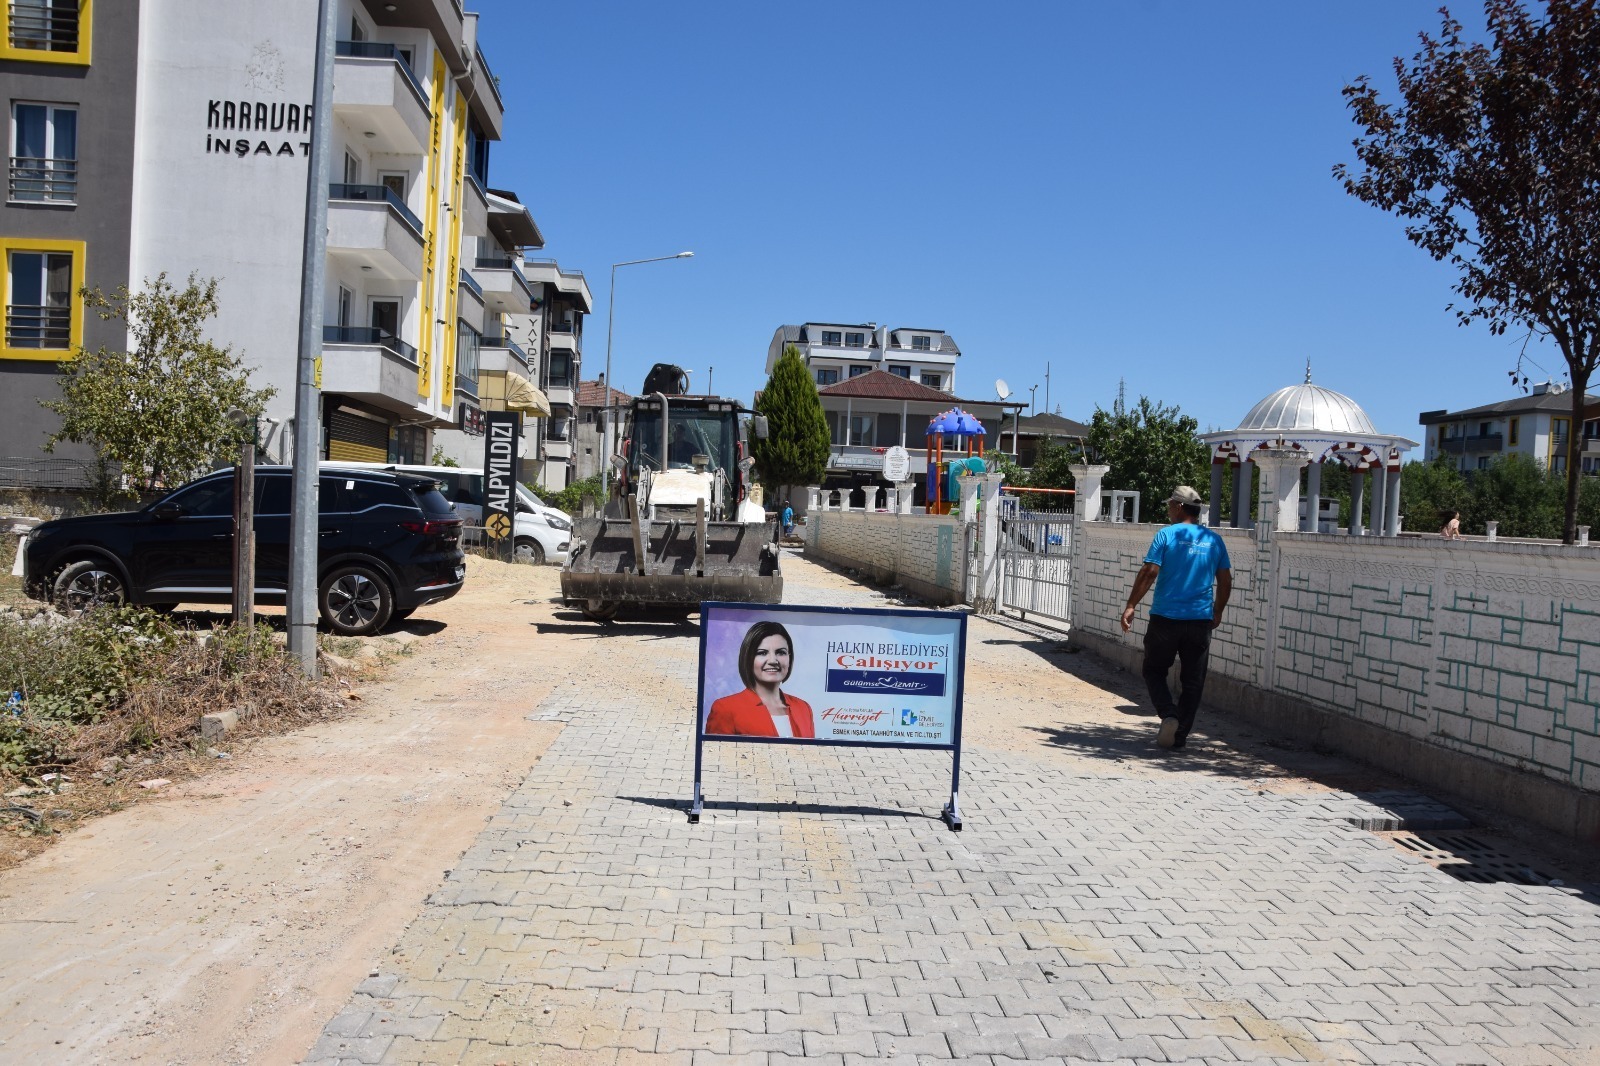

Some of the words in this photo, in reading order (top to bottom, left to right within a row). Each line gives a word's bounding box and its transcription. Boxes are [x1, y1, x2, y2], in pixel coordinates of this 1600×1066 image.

[206, 134, 310, 158] İNŞAAT
[487, 421, 514, 513] ALPYILDIZI
[827, 641, 875, 655] HALKIN
[877, 642, 949, 658] BELEDİYESİ
[836, 654, 939, 672] Çalışıyor
[843, 679, 881, 687] Gülümse
[894, 681, 920, 689] İZMİT
[820, 707, 891, 727] Hürriyet
